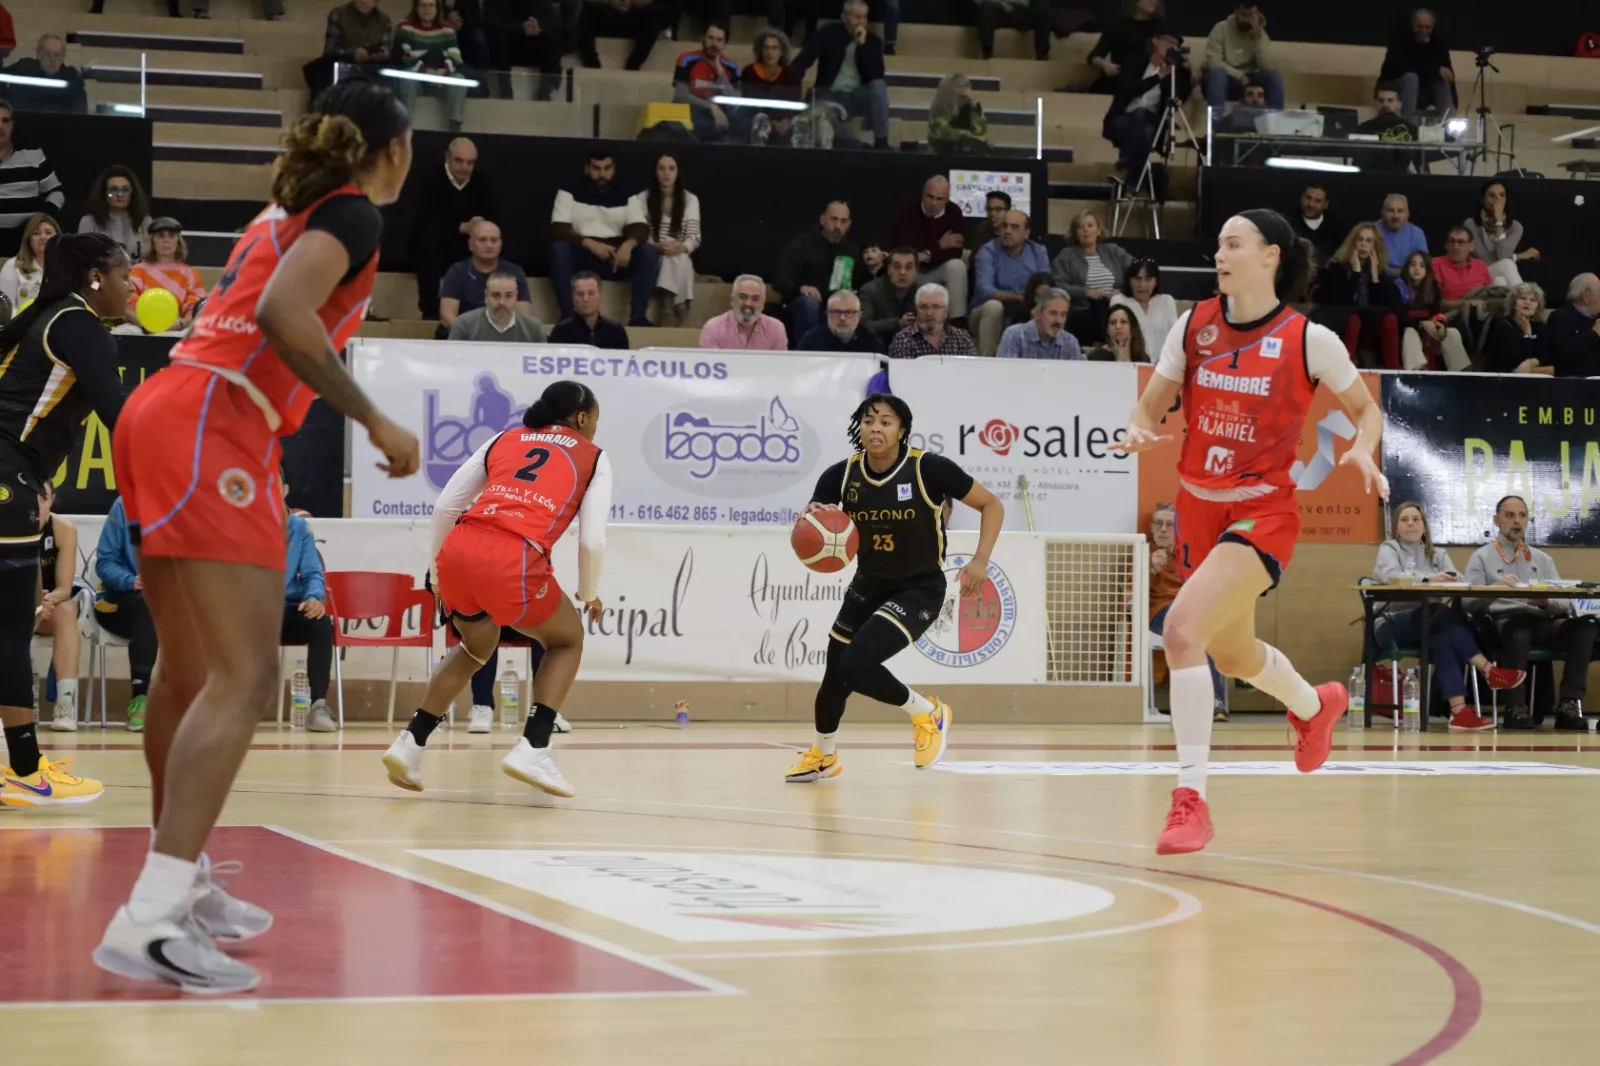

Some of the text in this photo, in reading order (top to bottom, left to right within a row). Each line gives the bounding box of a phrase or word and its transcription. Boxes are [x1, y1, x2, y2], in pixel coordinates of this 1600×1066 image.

[522, 355, 728, 380] ESPECTÁCULOS
[1228, 349, 1240, 370] 1
[1197, 365, 1272, 396] BEMBIBRE
[1518, 406, 1595, 426] EMBU
[520, 433, 578, 448] GARRAUD
[1197, 415, 1257, 443] PAJARIEL
[665, 412, 800, 479] legados
[514, 447, 551, 482] 2
[523, 489, 532, 497] Y
[533, 492, 557, 512] LEÓN
[693, 506, 717, 521] 865
[848, 508, 916, 521] HOZONO
[872, 534, 895, 552] 23
[753, 628, 776, 665] de
